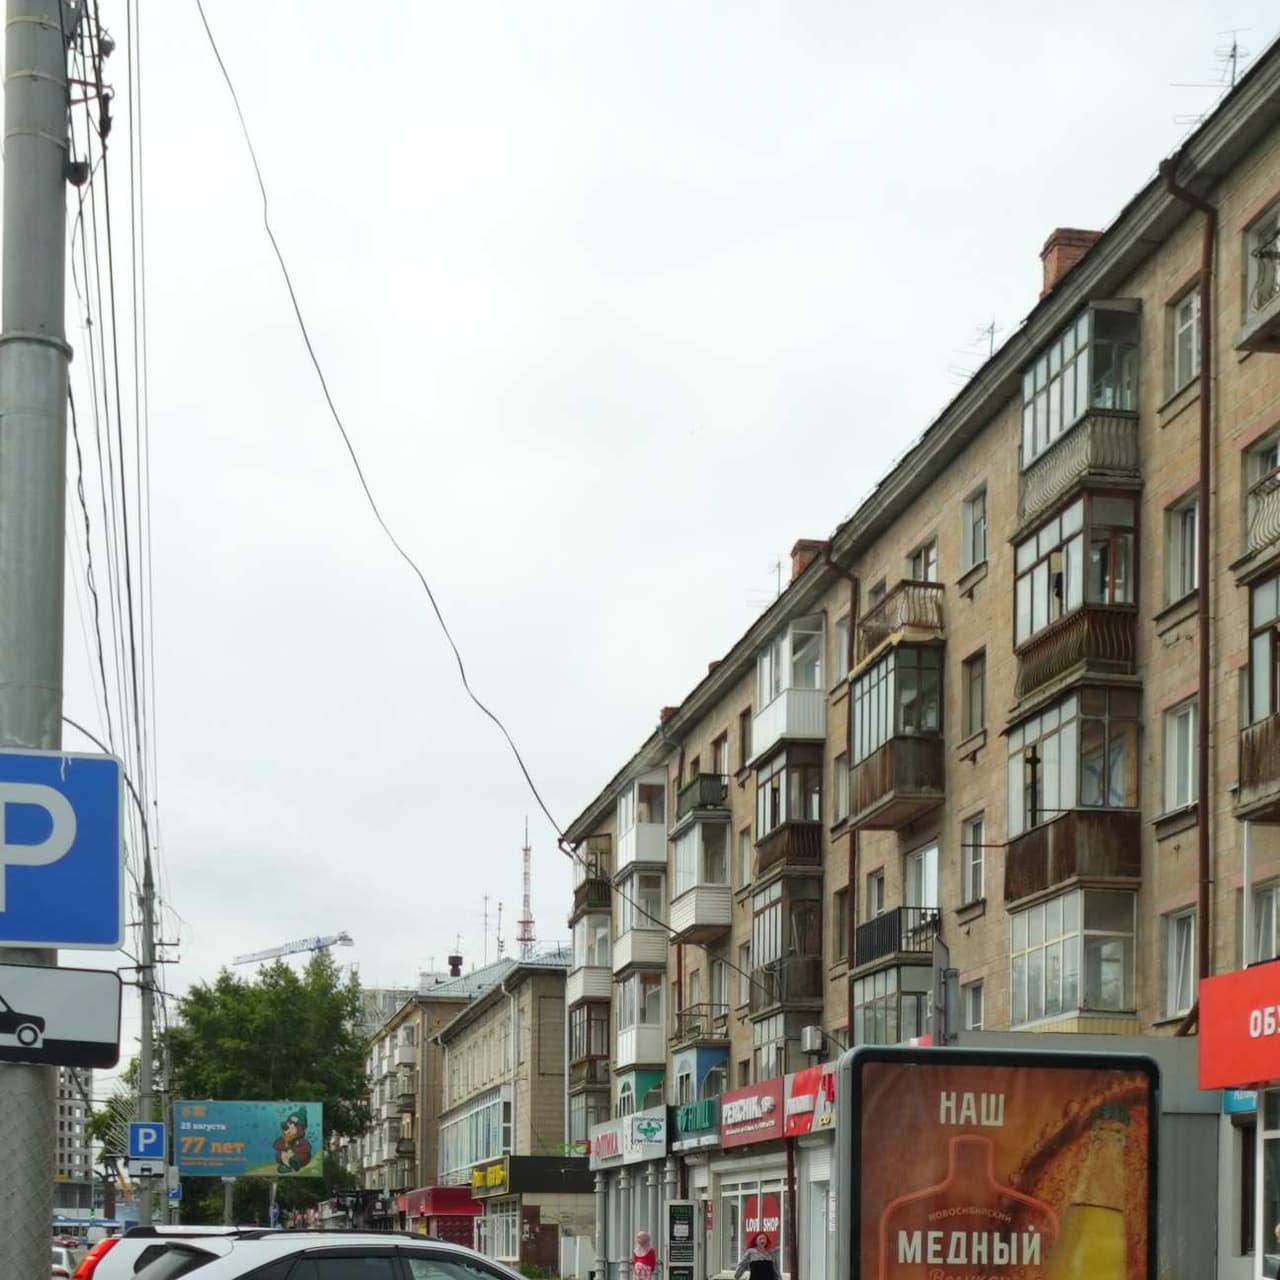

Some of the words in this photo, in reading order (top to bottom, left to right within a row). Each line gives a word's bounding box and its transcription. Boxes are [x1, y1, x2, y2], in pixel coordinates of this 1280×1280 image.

[939, 1091, 1005, 1127] НАШ
[138, 1127, 157, 1152] P
[180, 1136, 205, 1153] 77
[210, 1141, 245, 1153] лет
[763, 1217, 779, 1232] SHOP
[928, 1206, 1012, 1223] НОВОСИБИРСКИЙ
[897, 1225, 1041, 1266] МЕДНЫЙ
